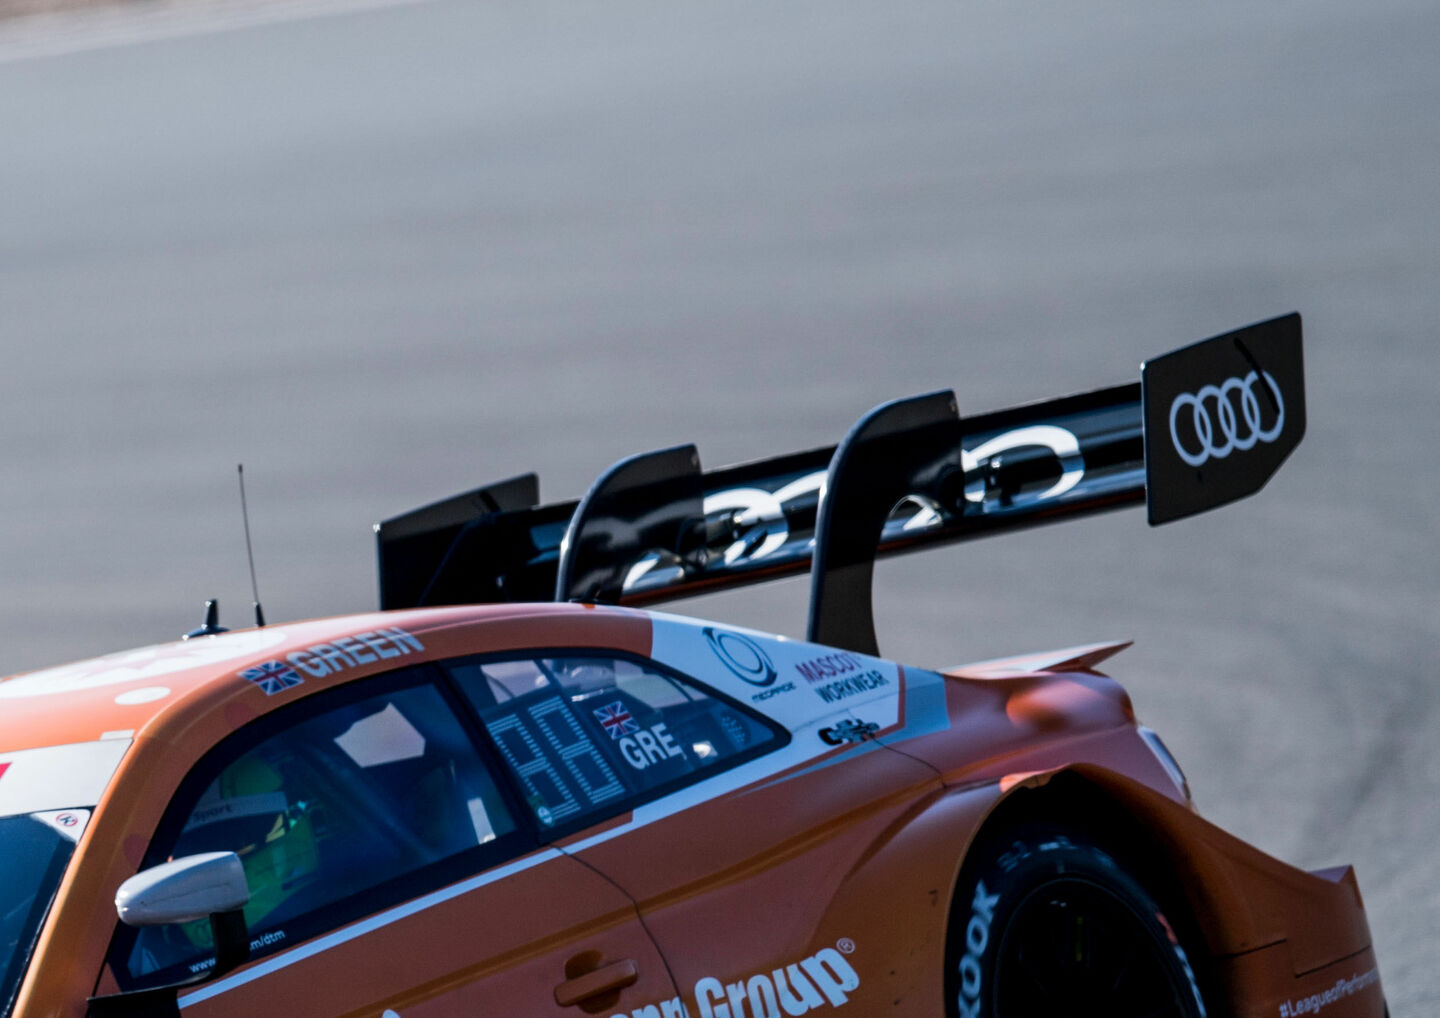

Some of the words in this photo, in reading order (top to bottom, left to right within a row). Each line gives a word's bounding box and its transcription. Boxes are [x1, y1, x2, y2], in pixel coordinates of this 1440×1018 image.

[286, 627, 425, 677] GREEN
[795, 652, 863, 683] MASCOT
[815, 670, 890, 703] WORKWEAR
[619, 723, 684, 770] GRE
